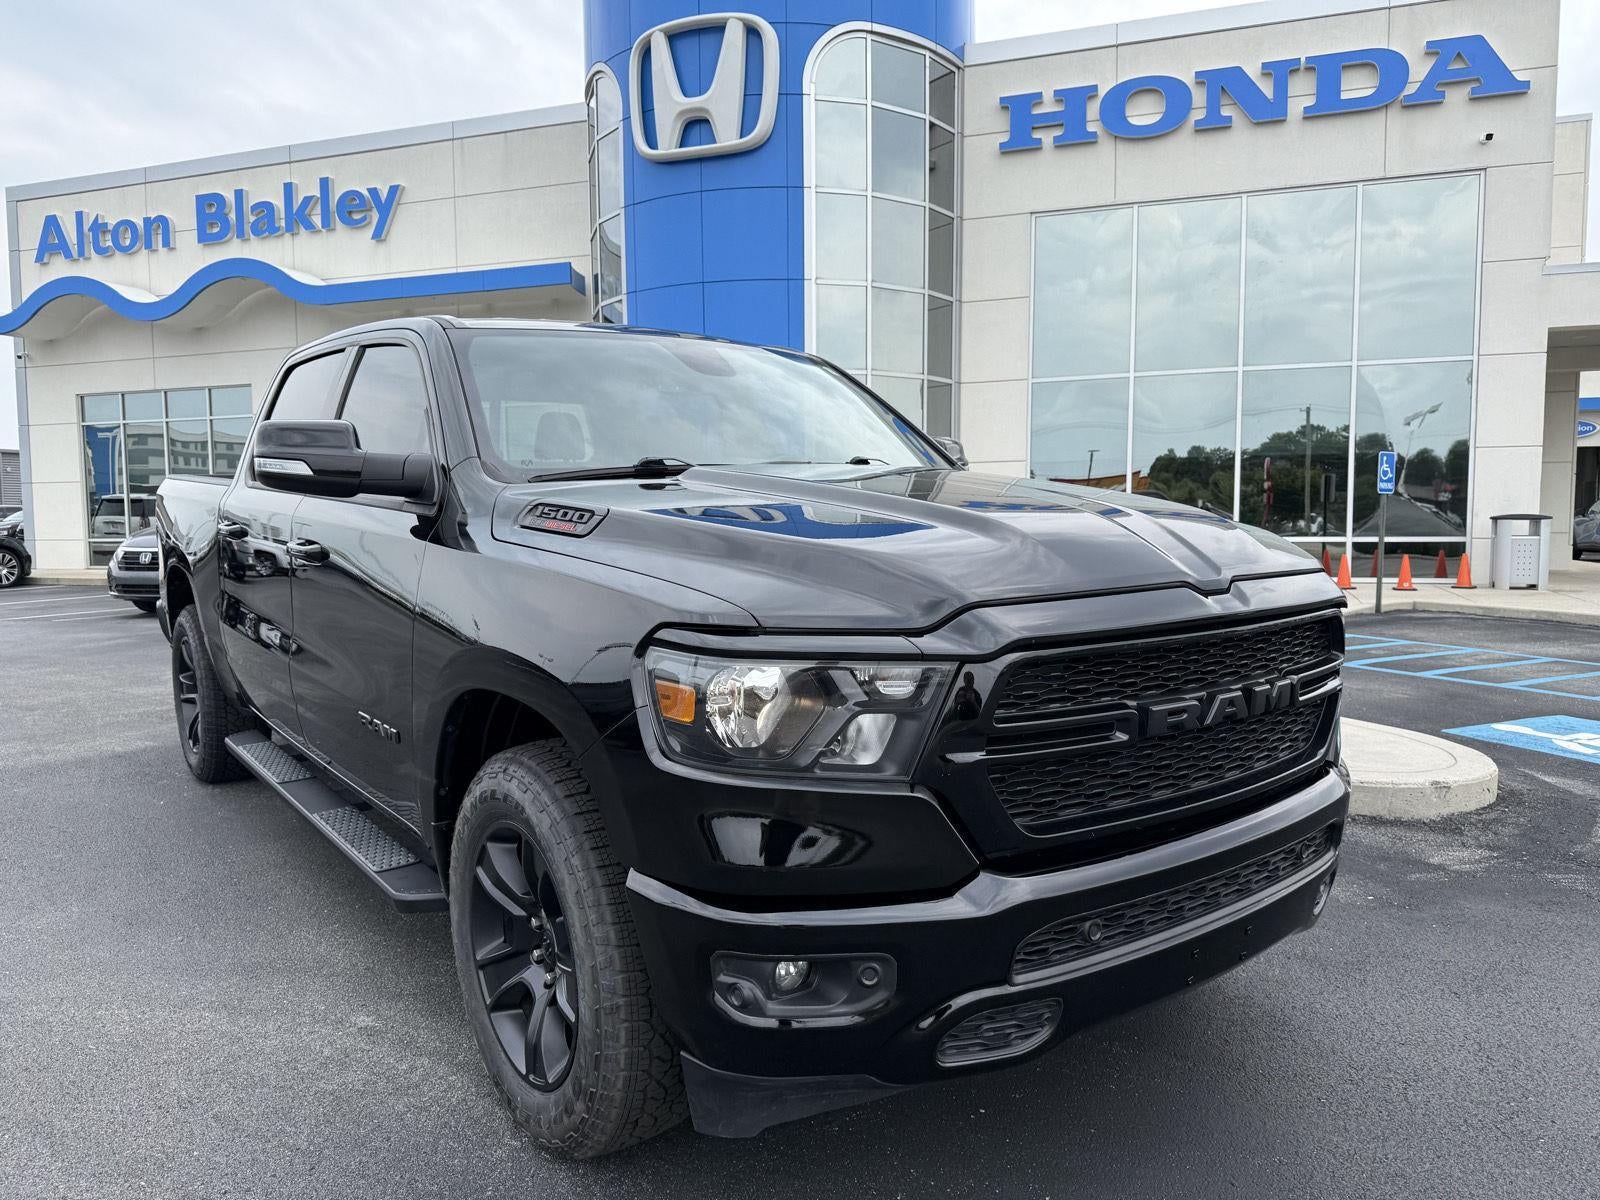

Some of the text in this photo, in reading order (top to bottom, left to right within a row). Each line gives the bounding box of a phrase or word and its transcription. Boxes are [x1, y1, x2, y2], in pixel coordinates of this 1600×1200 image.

[998, 34, 1530, 152] HONDA
[34, 177, 402, 264] Alton Blakley
[533, 505, 591, 523] 1500
[358, 710, 401, 744] RAM
[1147, 678, 1292, 737] RAM
